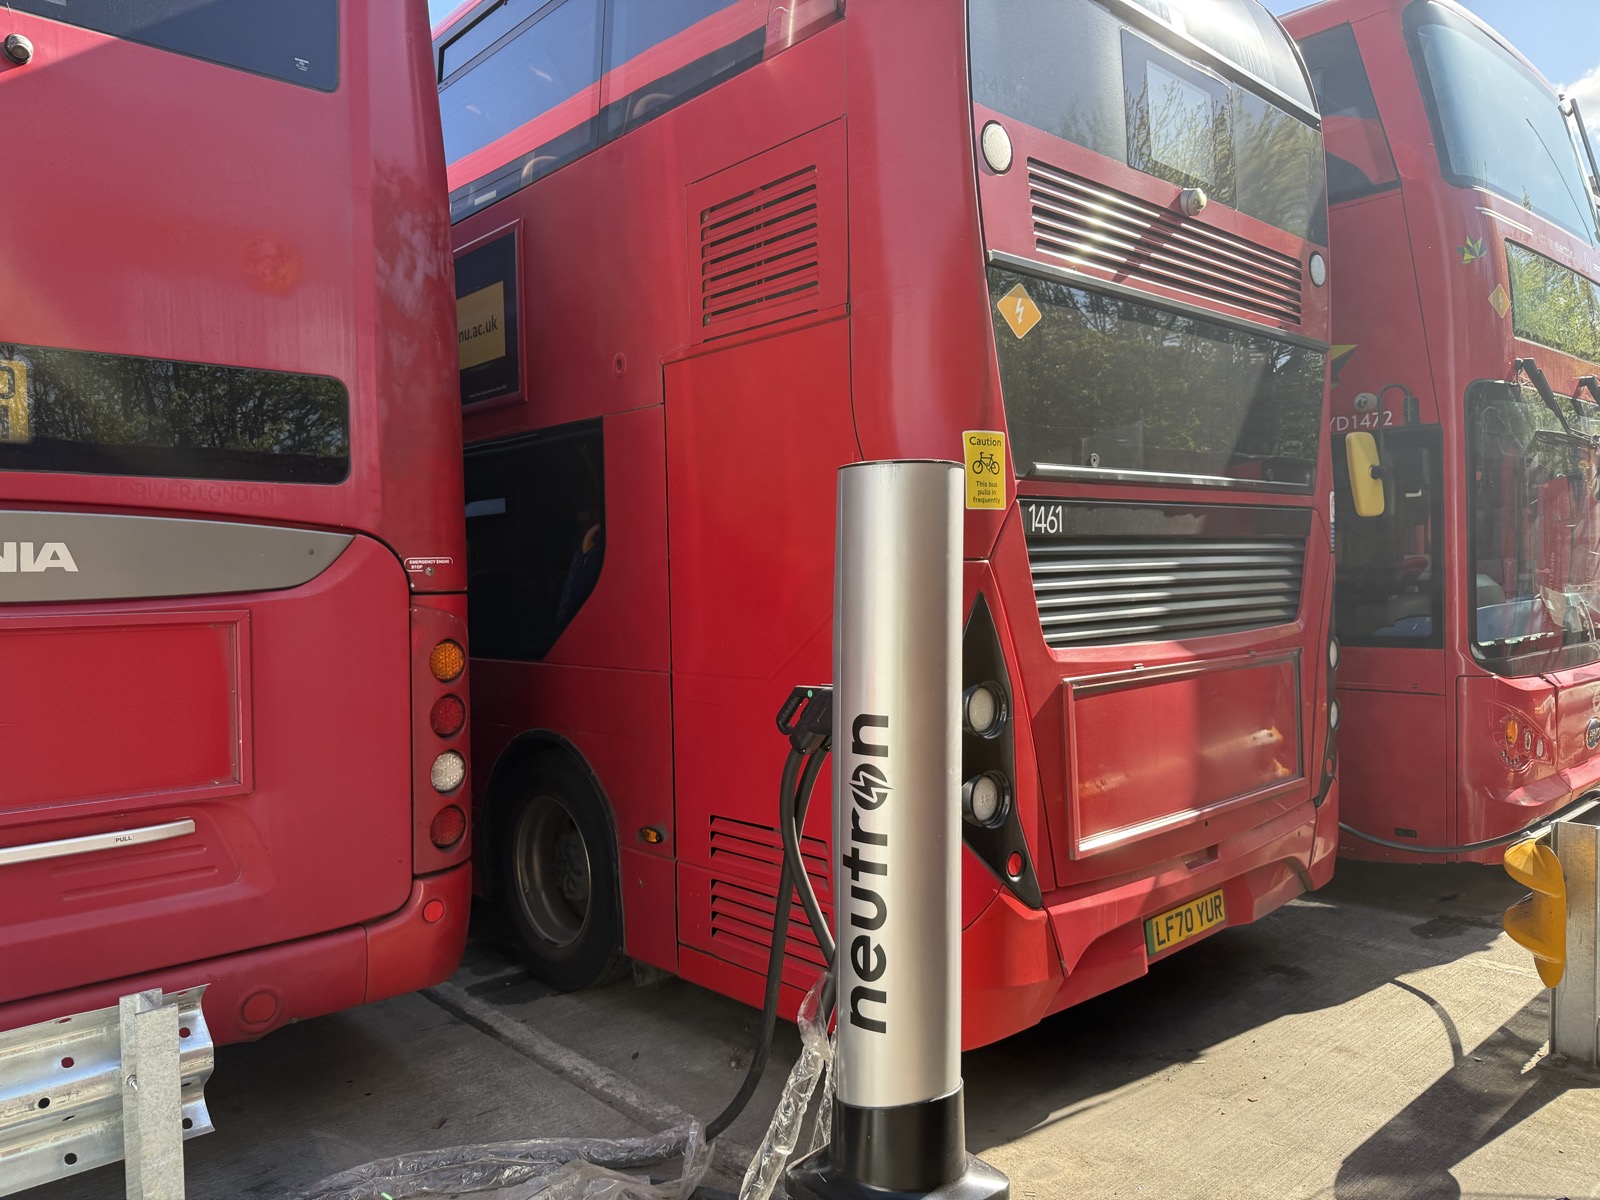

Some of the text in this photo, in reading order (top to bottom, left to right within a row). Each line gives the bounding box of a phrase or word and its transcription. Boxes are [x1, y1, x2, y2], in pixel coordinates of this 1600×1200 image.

[969, 436, 1002, 447] Caution
[972, 496, 1001, 505] frequently
[1028, 503, 1063, 534] 1461
[842, 713, 894, 1035] neutron
[1155, 894, 1223, 947] LF70 YUR
